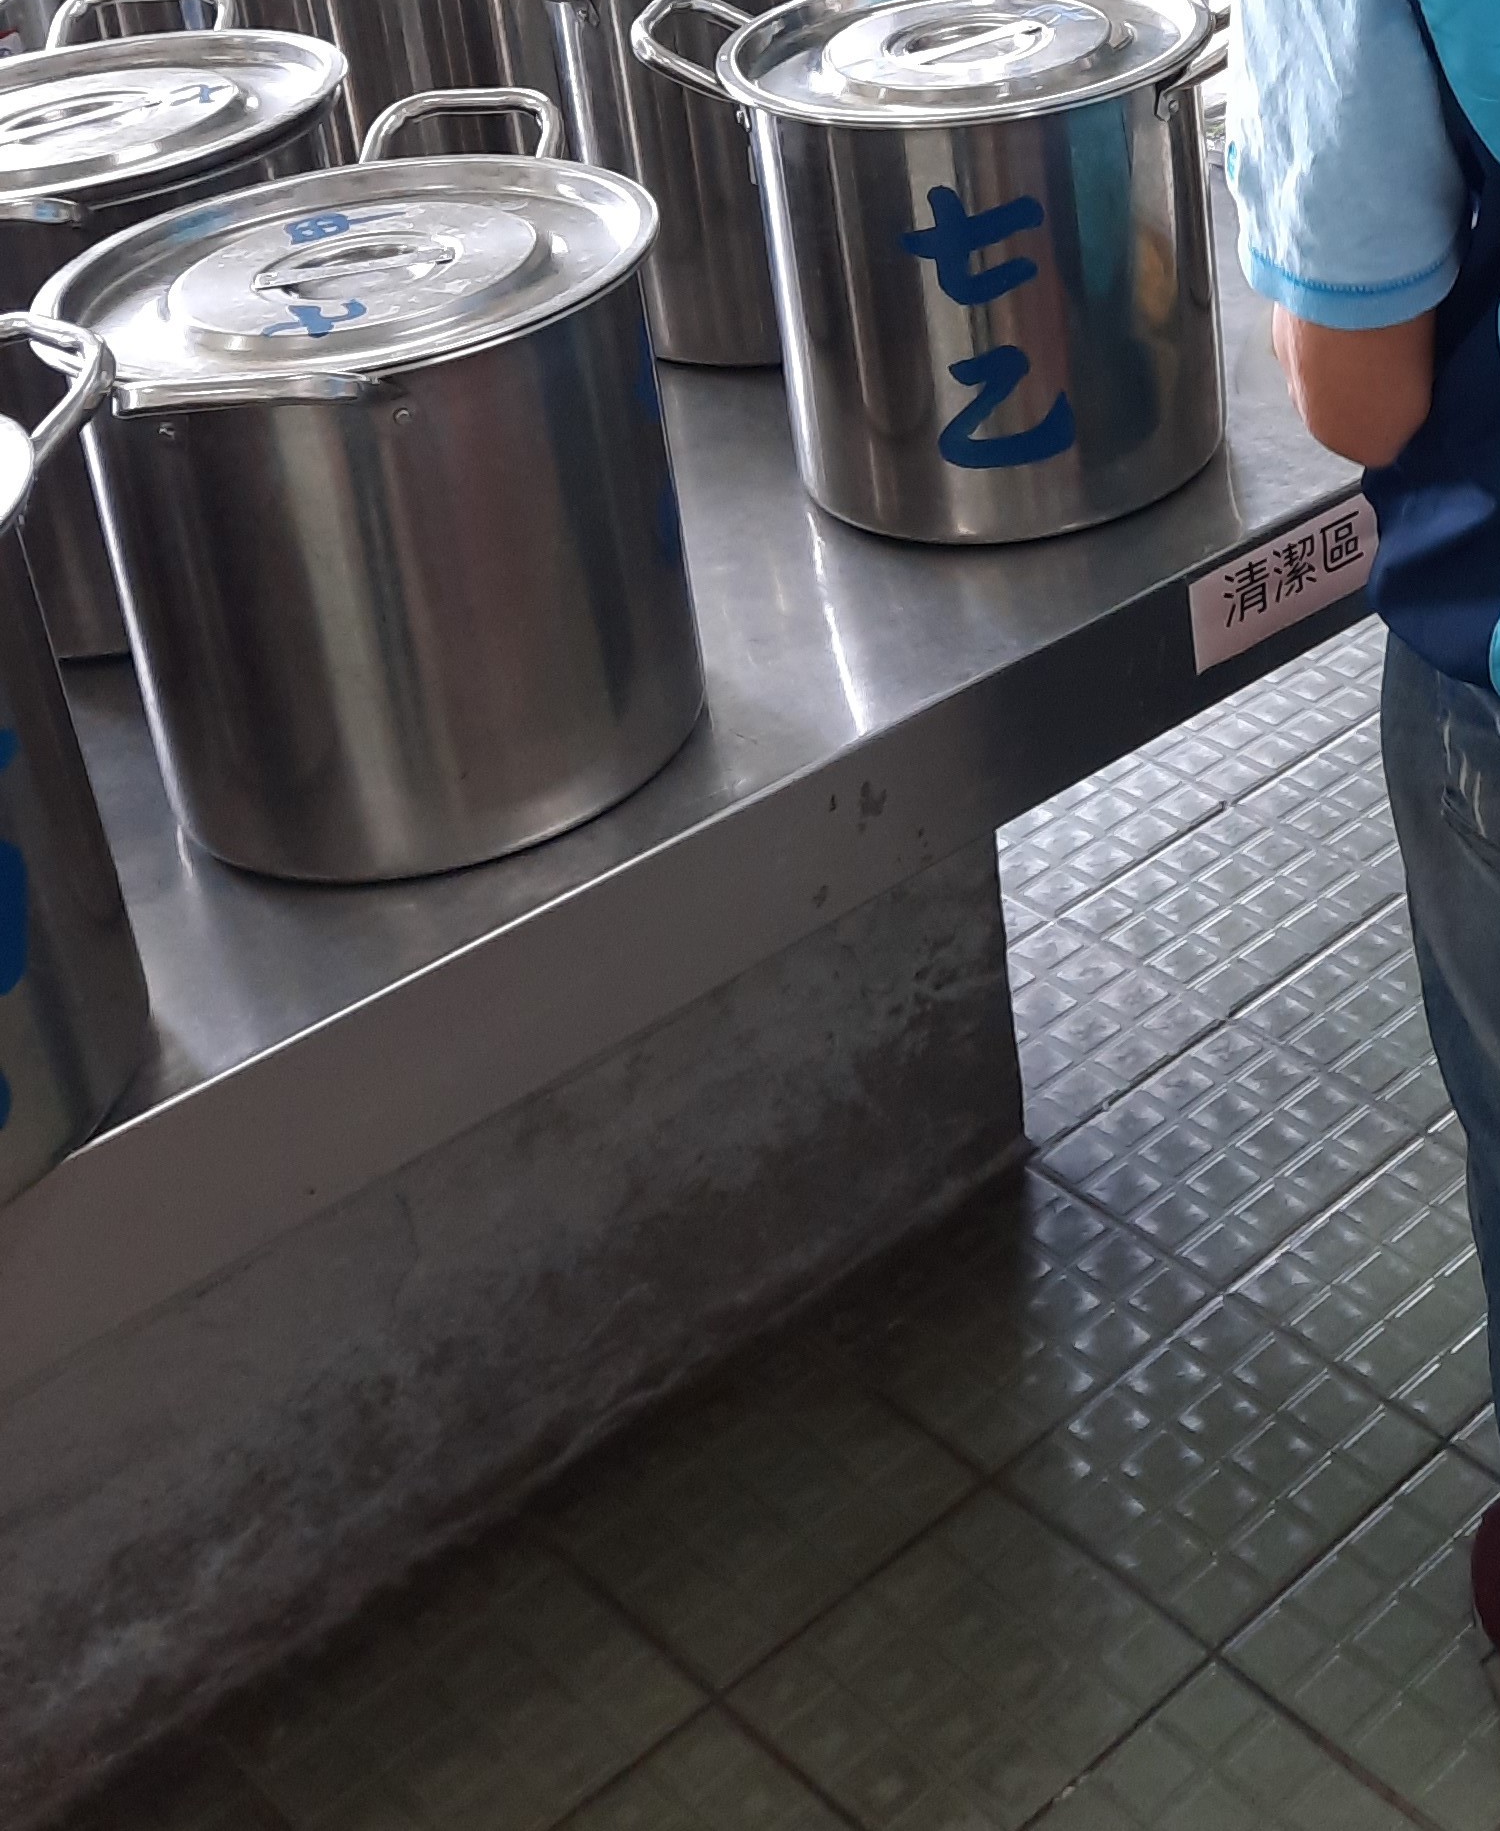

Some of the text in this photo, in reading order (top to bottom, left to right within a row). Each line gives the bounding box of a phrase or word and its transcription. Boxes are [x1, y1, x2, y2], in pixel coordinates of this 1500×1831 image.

[902, 185, 1076, 468] 七乙
[1223, 510, 1365, 628] 清潔區
